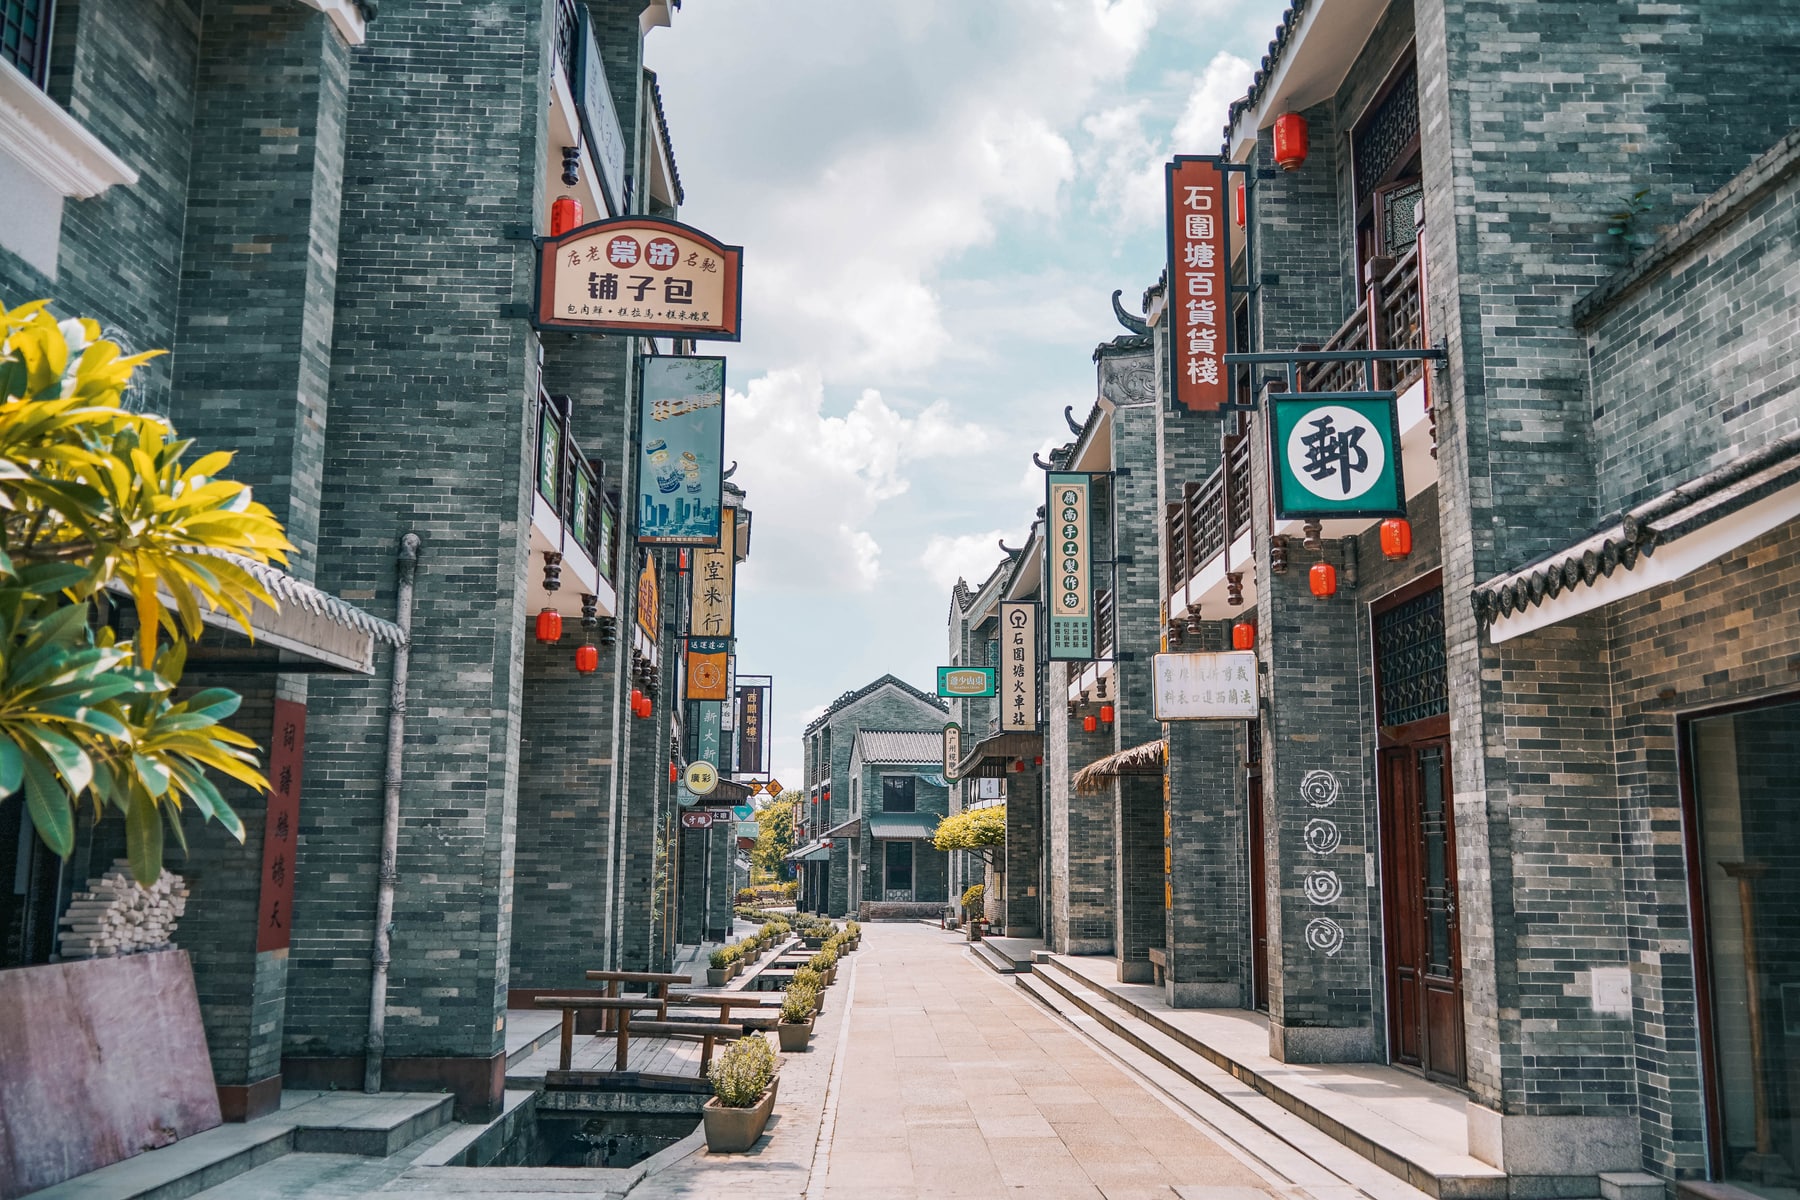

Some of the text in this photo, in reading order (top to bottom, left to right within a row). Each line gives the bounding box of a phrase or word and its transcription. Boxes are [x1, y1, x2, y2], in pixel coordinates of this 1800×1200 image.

[1183, 186, 1219, 385] 石圍塘百貨貨棧
[1300, 415, 1369, 495] 郵
[702, 548, 725, 634] 堂米行
[1062, 491, 1079, 608] 嶺南手工製作坊
[1012, 632, 1027, 726] 石圍塘火車站
[690, 773, 712, 783] 廣彩
[702, 709, 718, 762] 新大新
